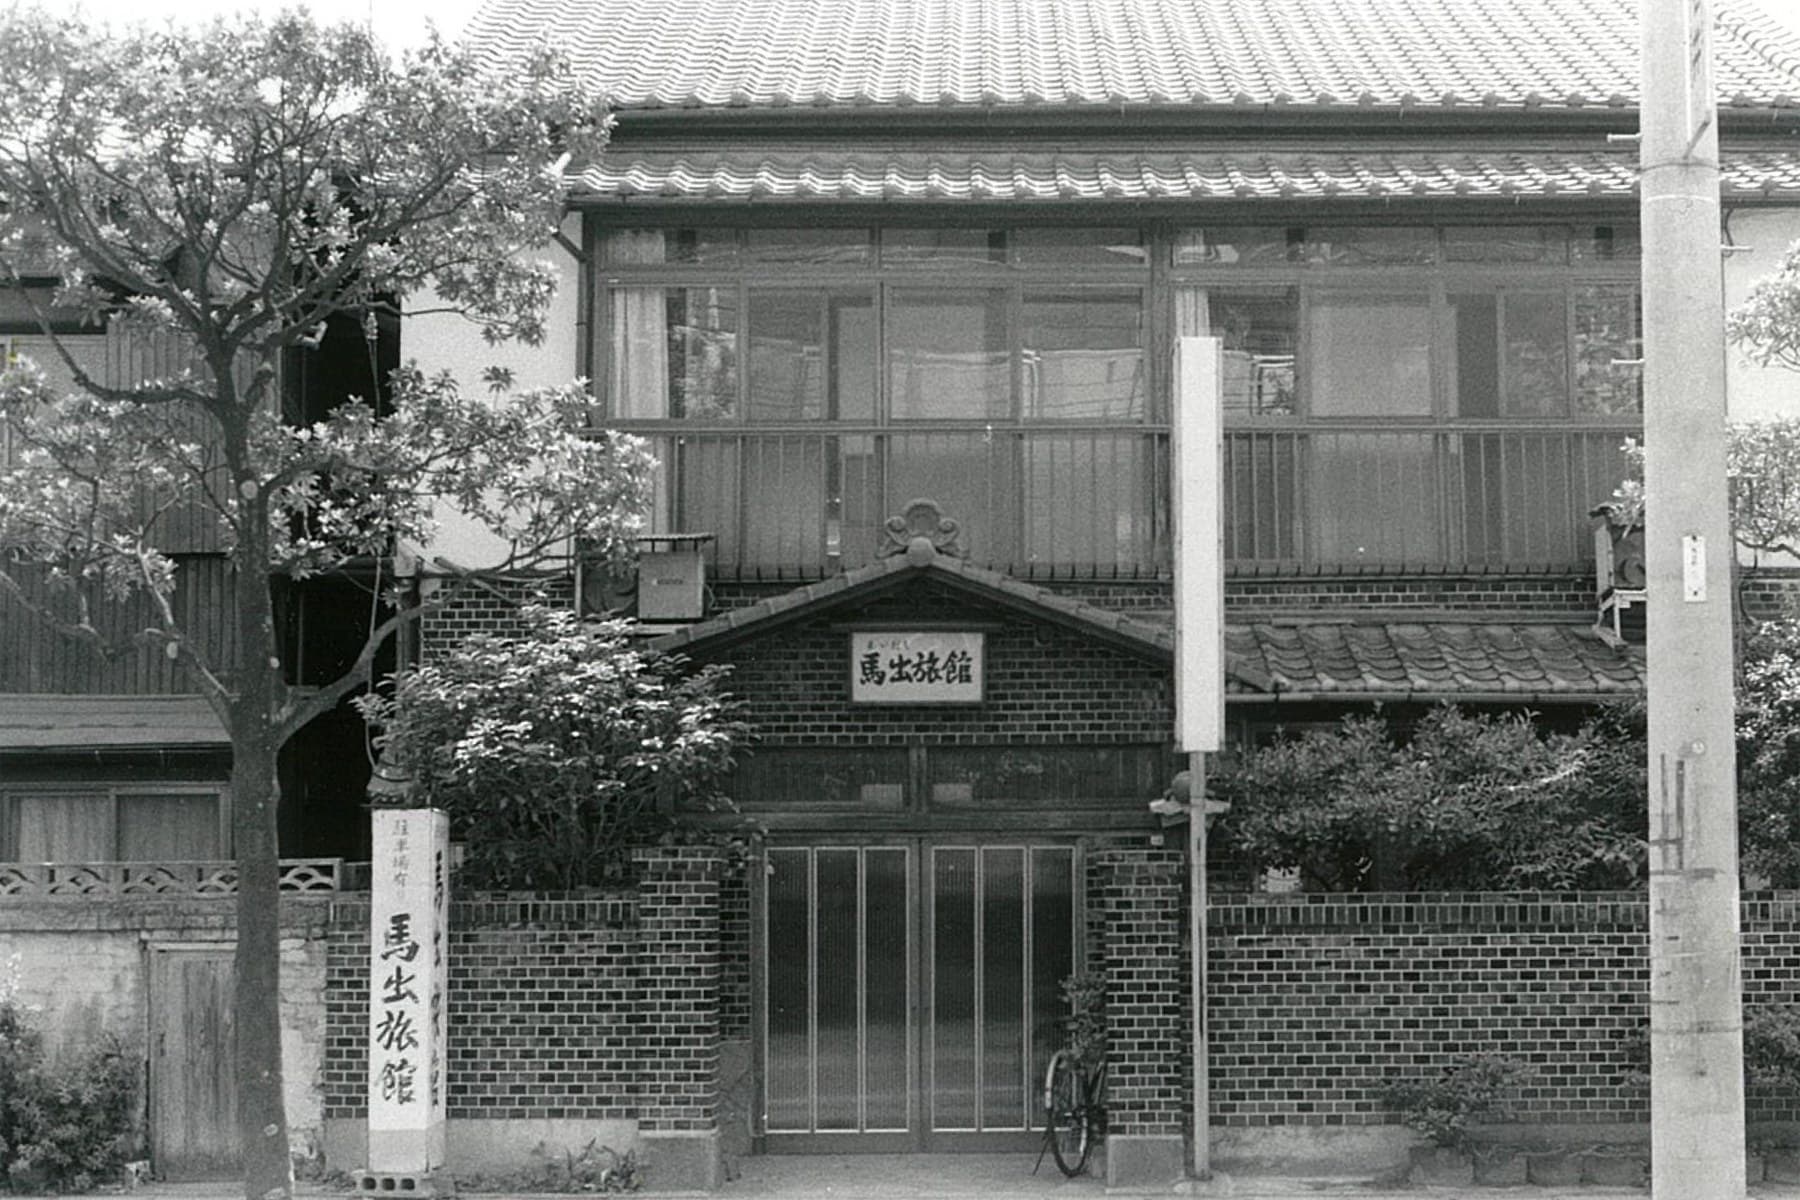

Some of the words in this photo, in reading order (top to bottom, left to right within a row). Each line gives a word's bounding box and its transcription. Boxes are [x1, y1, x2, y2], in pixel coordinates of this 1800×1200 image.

[860, 650, 974, 686] 馬出旅館
[375, 912, 421, 1106] 馬出旅館
